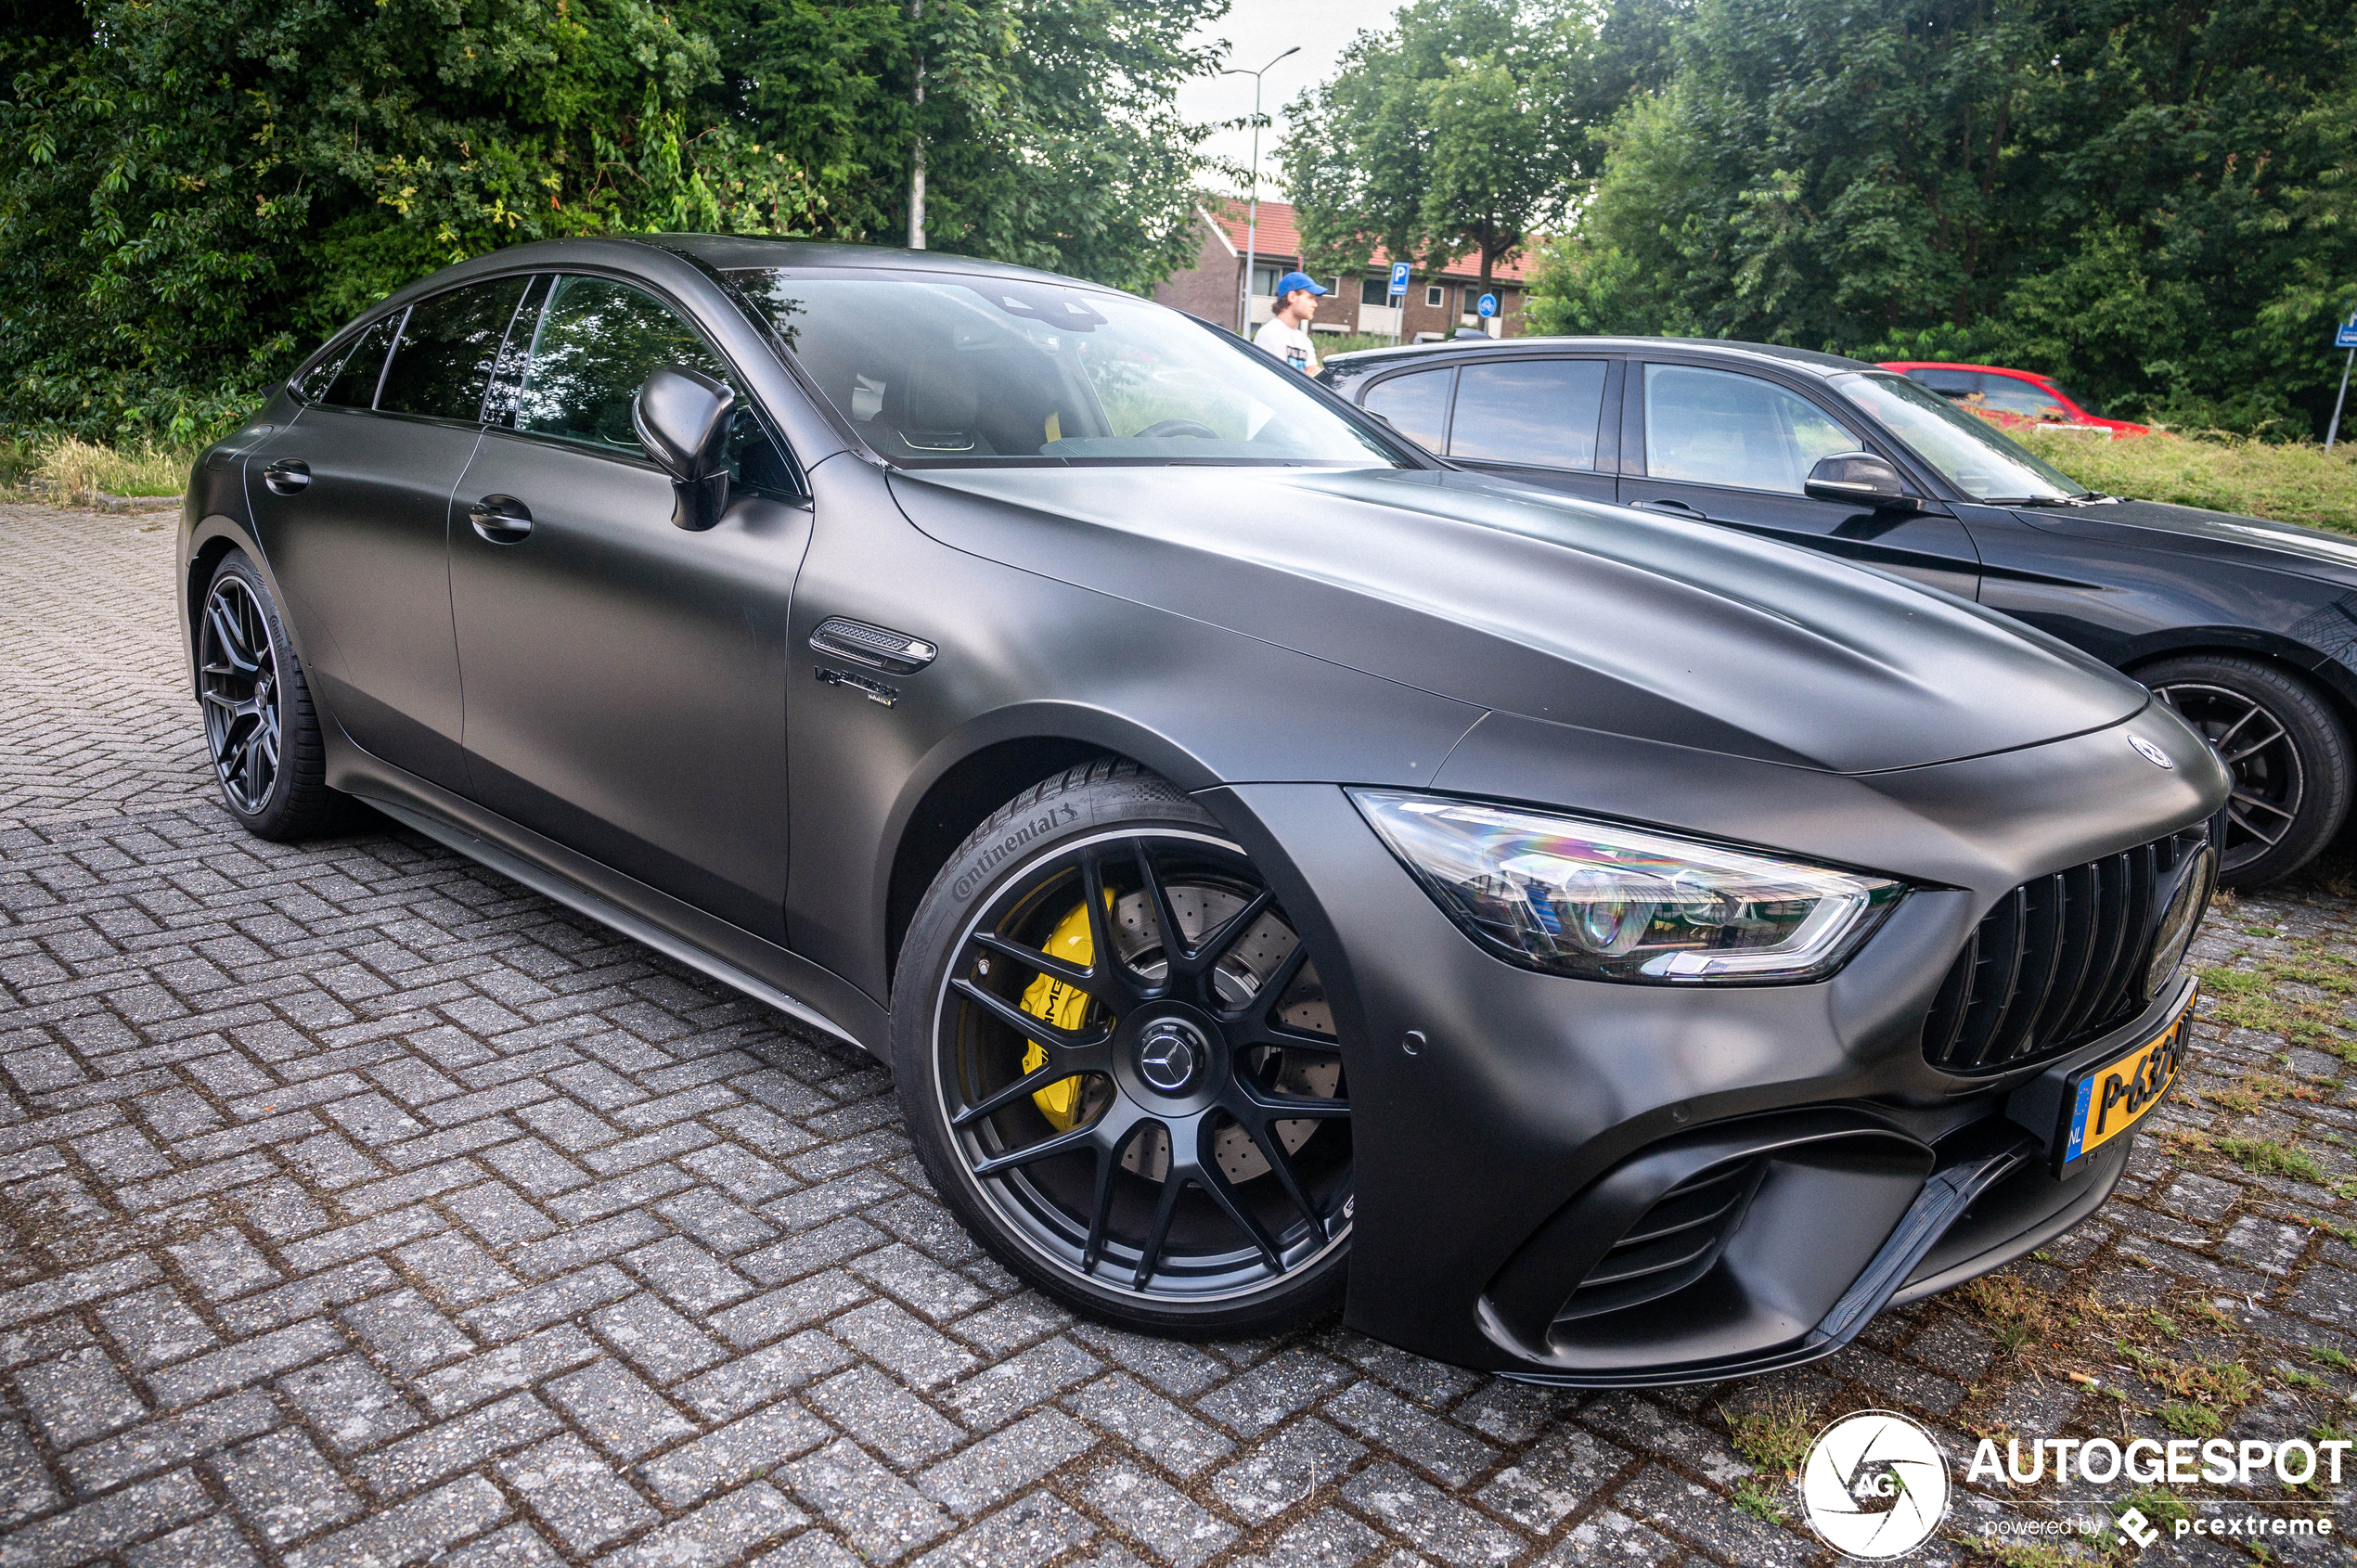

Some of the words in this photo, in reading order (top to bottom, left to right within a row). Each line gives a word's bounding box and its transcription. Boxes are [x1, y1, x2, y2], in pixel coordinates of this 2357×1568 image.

[1395, 266, 1406, 282] P
[951, 808, 1060, 903] Continental
[2067, 1126, 2081, 1147] NL
